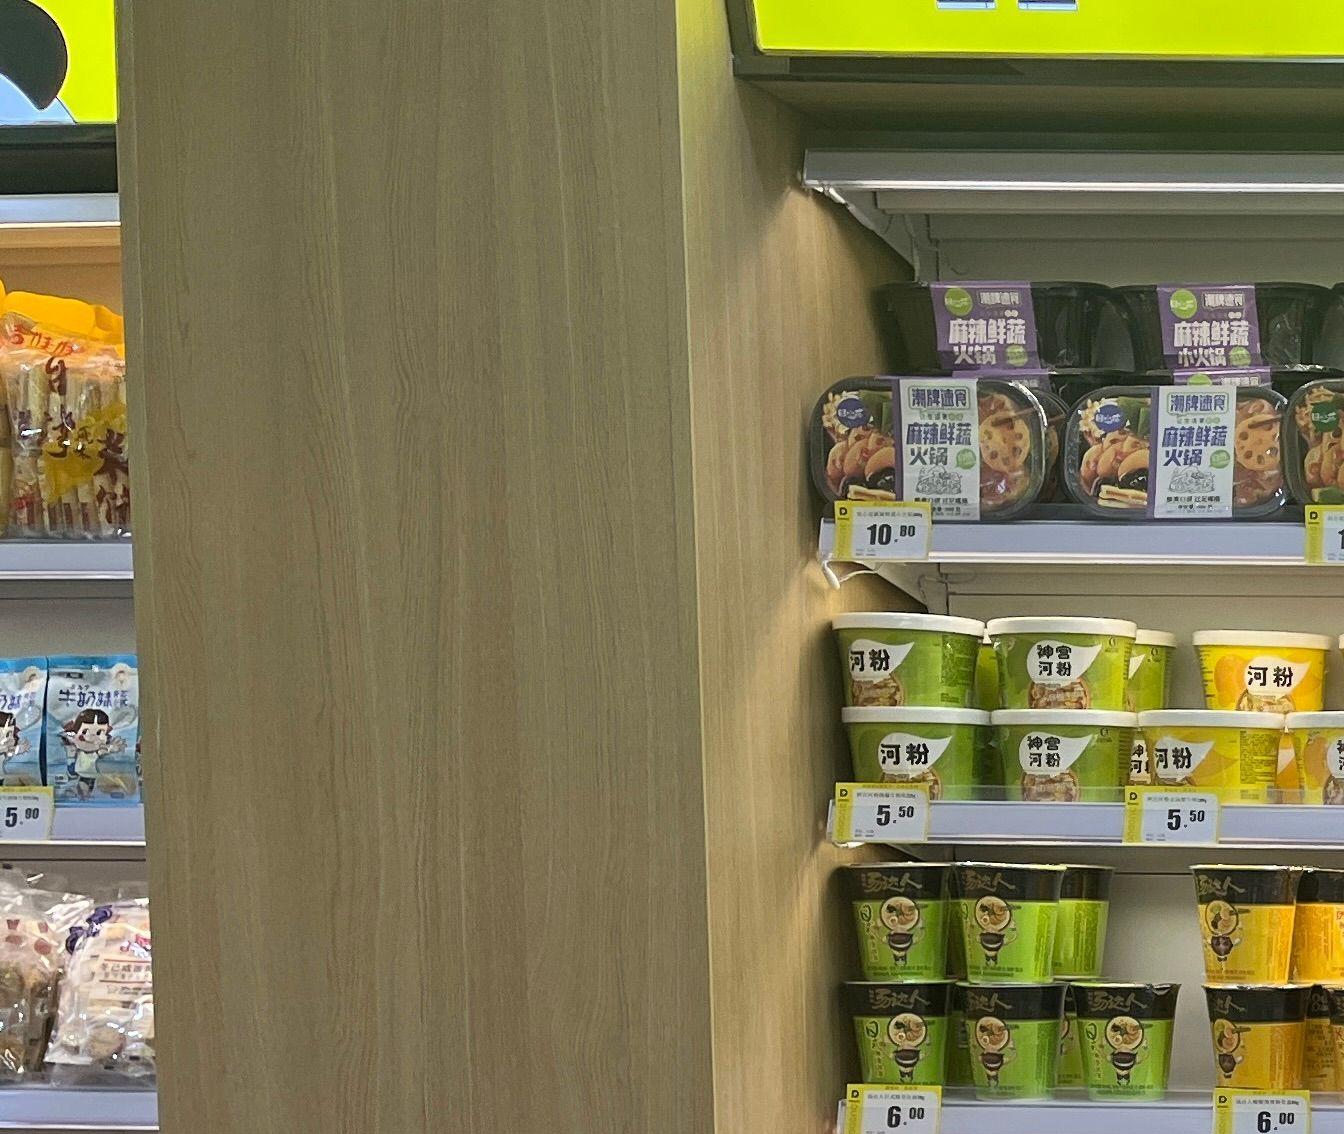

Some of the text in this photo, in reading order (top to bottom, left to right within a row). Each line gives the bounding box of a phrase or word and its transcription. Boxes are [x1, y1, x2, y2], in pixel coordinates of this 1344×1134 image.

[953, 347, 997, 365] 火锅
[906, 423, 973, 446] 麻辣鲜蔬
[1161, 425, 1228, 448] 麻辣鲜蔬
[909, 447, 949, 467] 火锅
[1163, 448, 1203, 467] 火锅
[850, 650, 889, 672] 河粉
[1038, 660, 1071, 677] 河粉
[1248, 666, 1294, 687] 河粉
[880, 743, 929, 765] 河粉
[1029, 751, 1061, 767] 河粉
[1155, 748, 1192, 769] 河粉
[876, 804, 914, 826] 5.50
[1167, 809, 1205, 831] 5.50
[862, 871, 923, 893] 汤达人
[868, 988, 932, 1010] 汤达人
[887, 1105, 924, 1129] 6.00
[1257, 1110, 1295, 1133] 6.00
